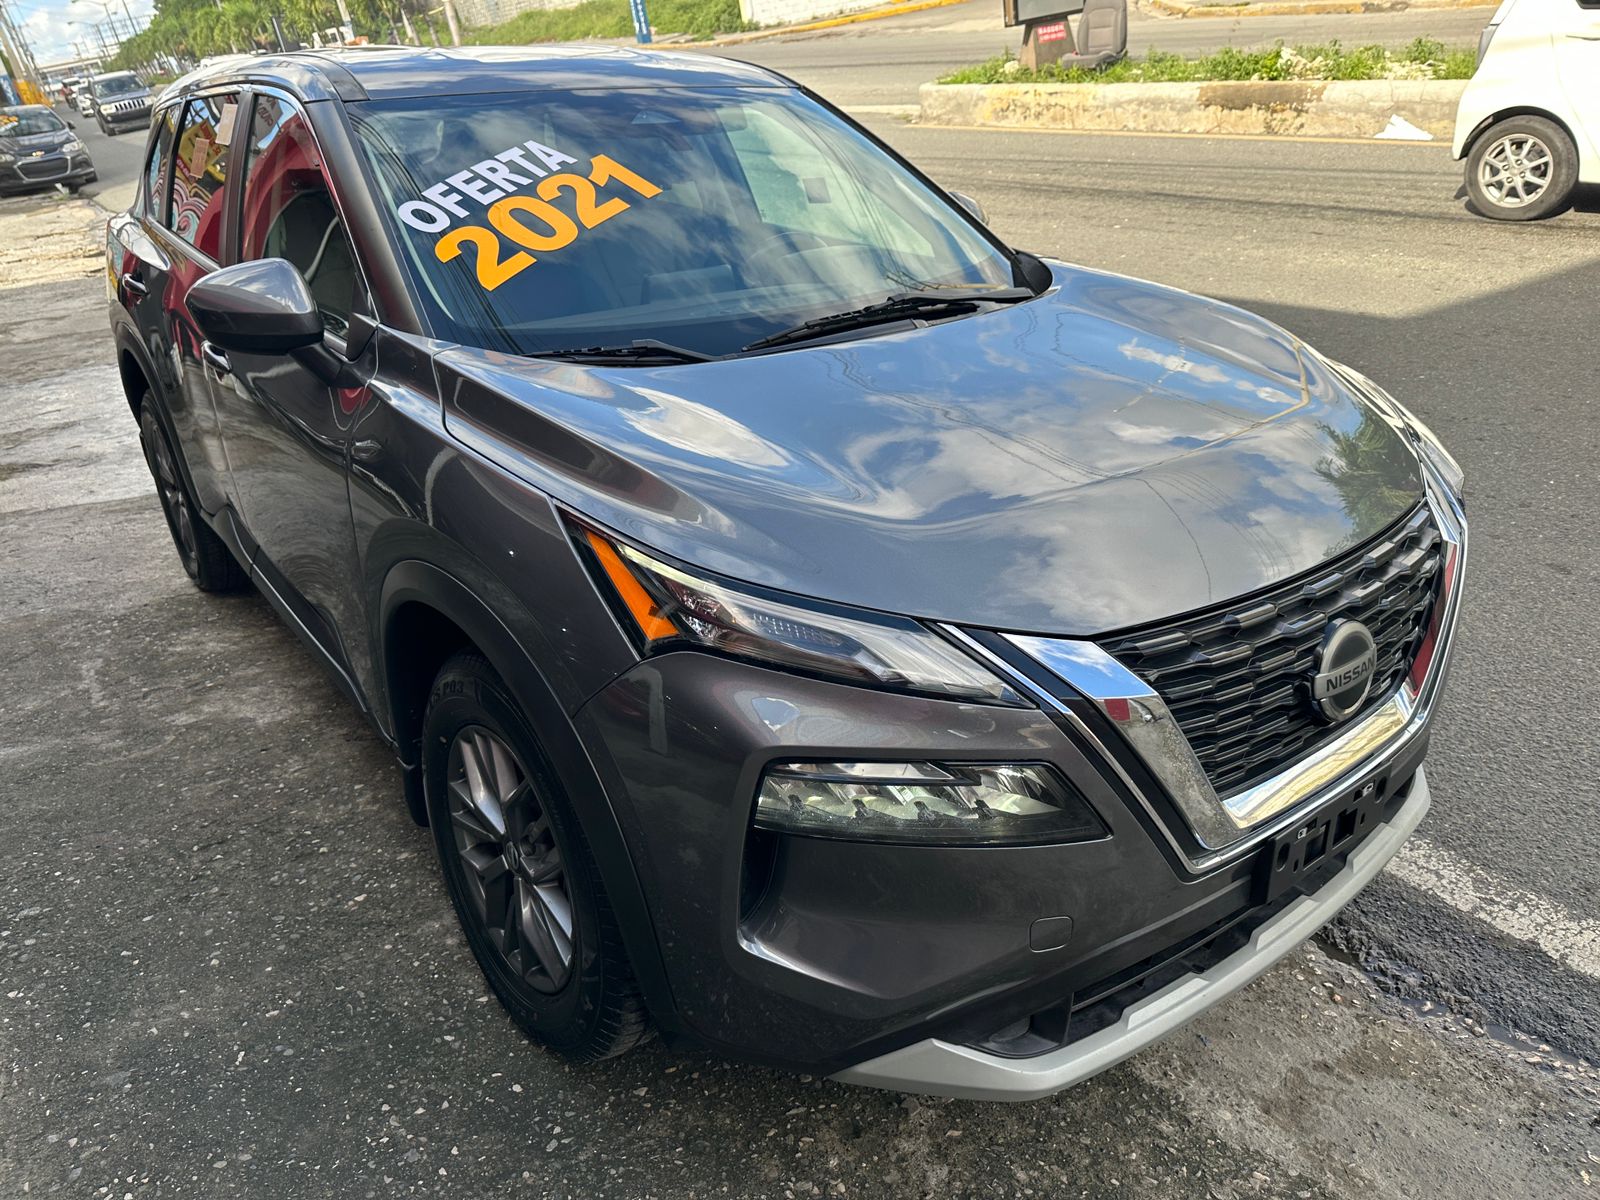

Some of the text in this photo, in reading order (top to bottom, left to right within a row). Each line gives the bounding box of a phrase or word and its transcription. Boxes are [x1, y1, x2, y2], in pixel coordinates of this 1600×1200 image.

[397, 139, 578, 234] OFERTA
[434, 153, 664, 292] 2021
[1325, 655, 1375, 692] NISSAN
